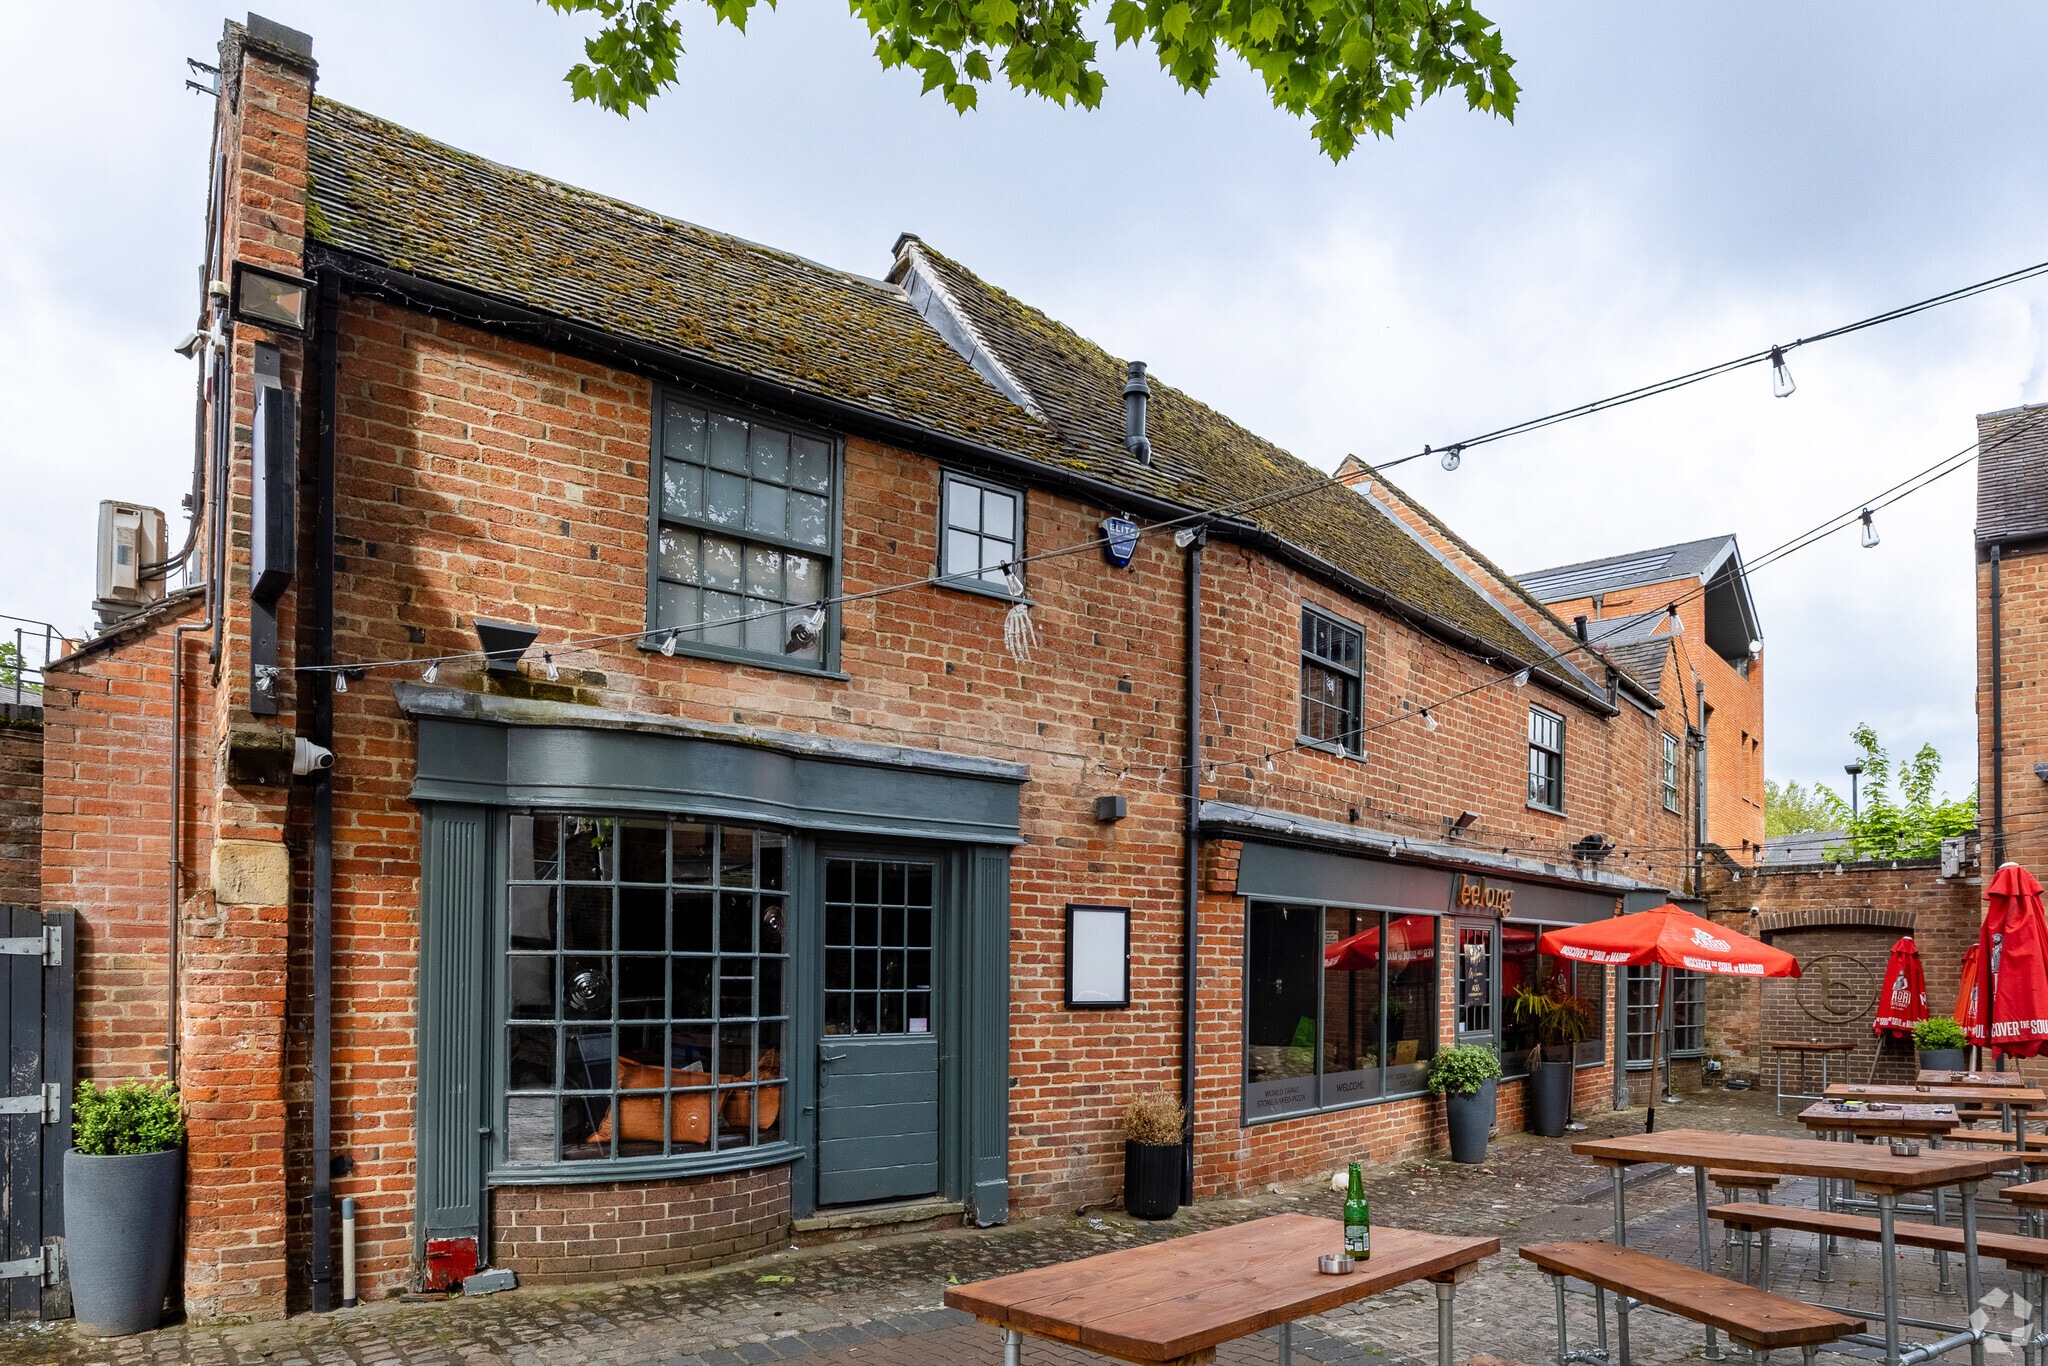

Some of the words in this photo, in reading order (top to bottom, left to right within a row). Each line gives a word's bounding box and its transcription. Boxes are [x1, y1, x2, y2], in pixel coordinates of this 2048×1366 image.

[1109, 523, 1136, 536] ELITE
[1560, 945, 1588, 959] DISCOVER
[1592, 950, 1607, 962] SOUL
[1683, 956, 1712, 971] DISCOVER
[1718, 962, 1734, 973] SOUL
[1738, 963, 1765, 975] MADRID
[2020, 1020, 2031, 1029] THE
[1264, 1088, 1284, 1098] WORLD
[1284, 1086, 1300, 1095] TAPAS
[1336, 1080, 1365, 1093] WELCOME
[1256, 1099, 1274, 1108] STONE
[1292, 1094, 1307, 1103] PIZZA
